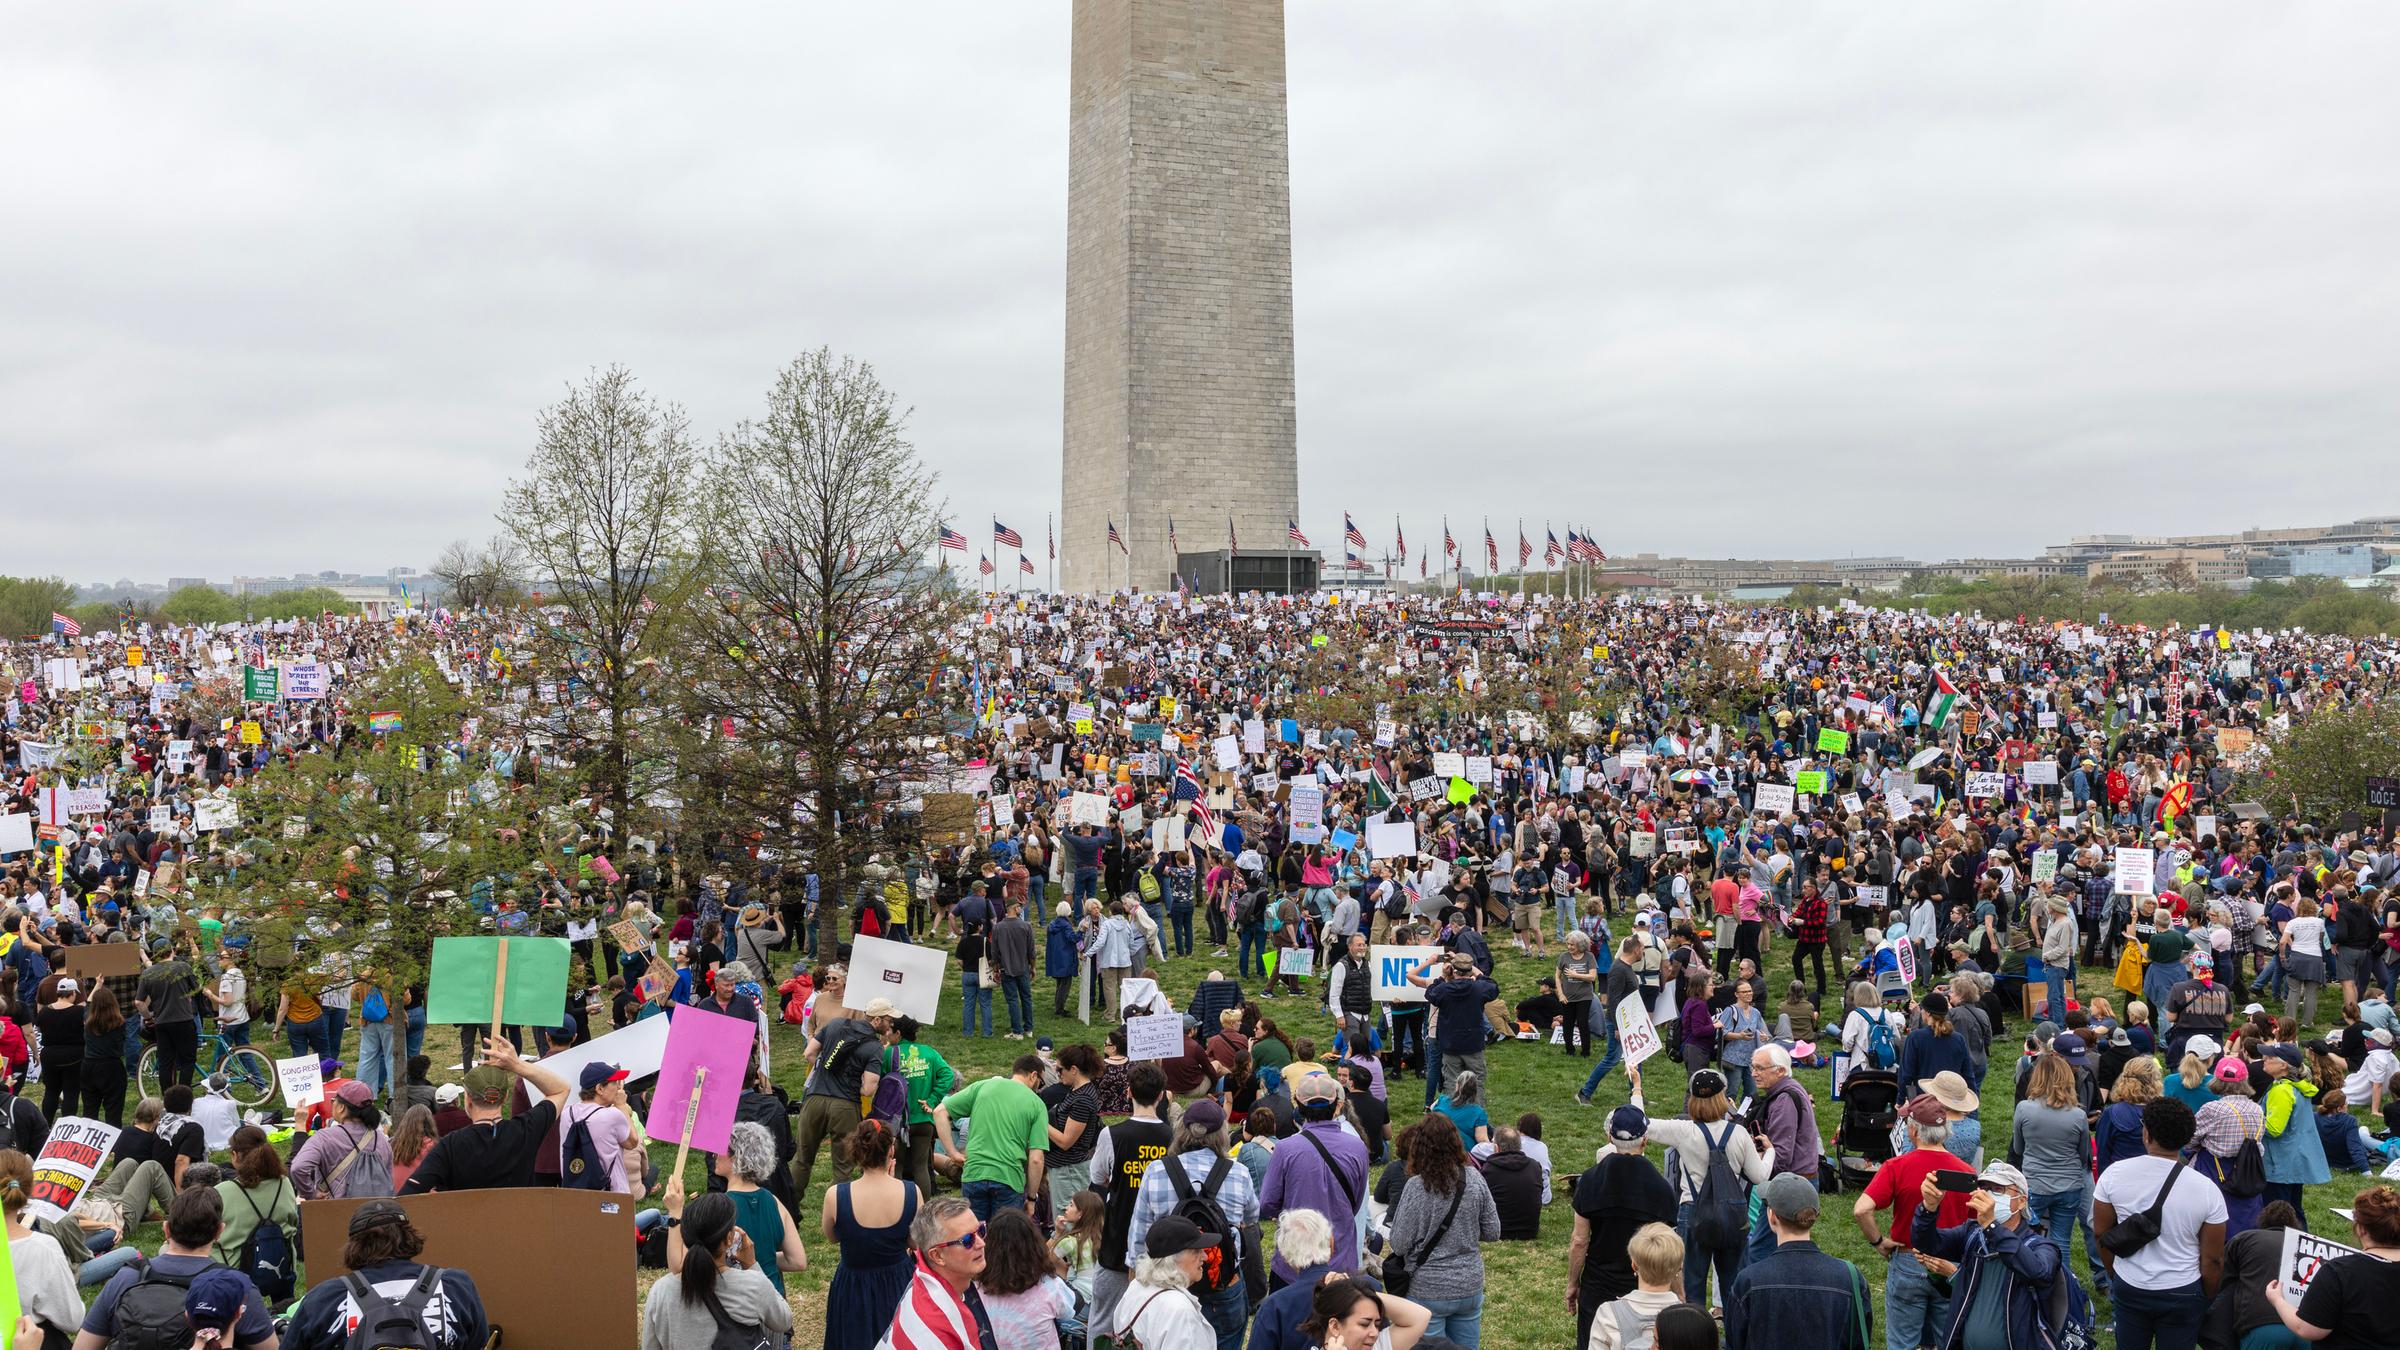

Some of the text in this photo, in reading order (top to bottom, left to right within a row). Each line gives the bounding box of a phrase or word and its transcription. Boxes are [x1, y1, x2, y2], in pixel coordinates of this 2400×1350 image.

[1414, 624, 1445, 637] Fascism
[1409, 775, 1438, 789] HISTORY
[2368, 778, 2395, 788] BEWARE
[2370, 790, 2397, 806] DOGE
[69, 804, 102, 813] TREASON
[2036, 869, 2053, 879] CARE
[1280, 951, 1313, 974] SHAME
[1133, 1031, 1176, 1044] MINORITY
[824, 1039, 845, 1070] NATHAN
[280, 1061, 320, 1076] CONGRESS
[290, 1082, 313, 1093] JOB
[51, 1123, 111, 1151] STOP THE
[40, 1141, 101, 1170] GENOCIDE
[1138, 1145, 1167, 1159] STOP
[46, 1169, 84, 1193] EMBARGO
[31, 1181, 76, 1207] OW
[2299, 1237, 2356, 1261] HAN
